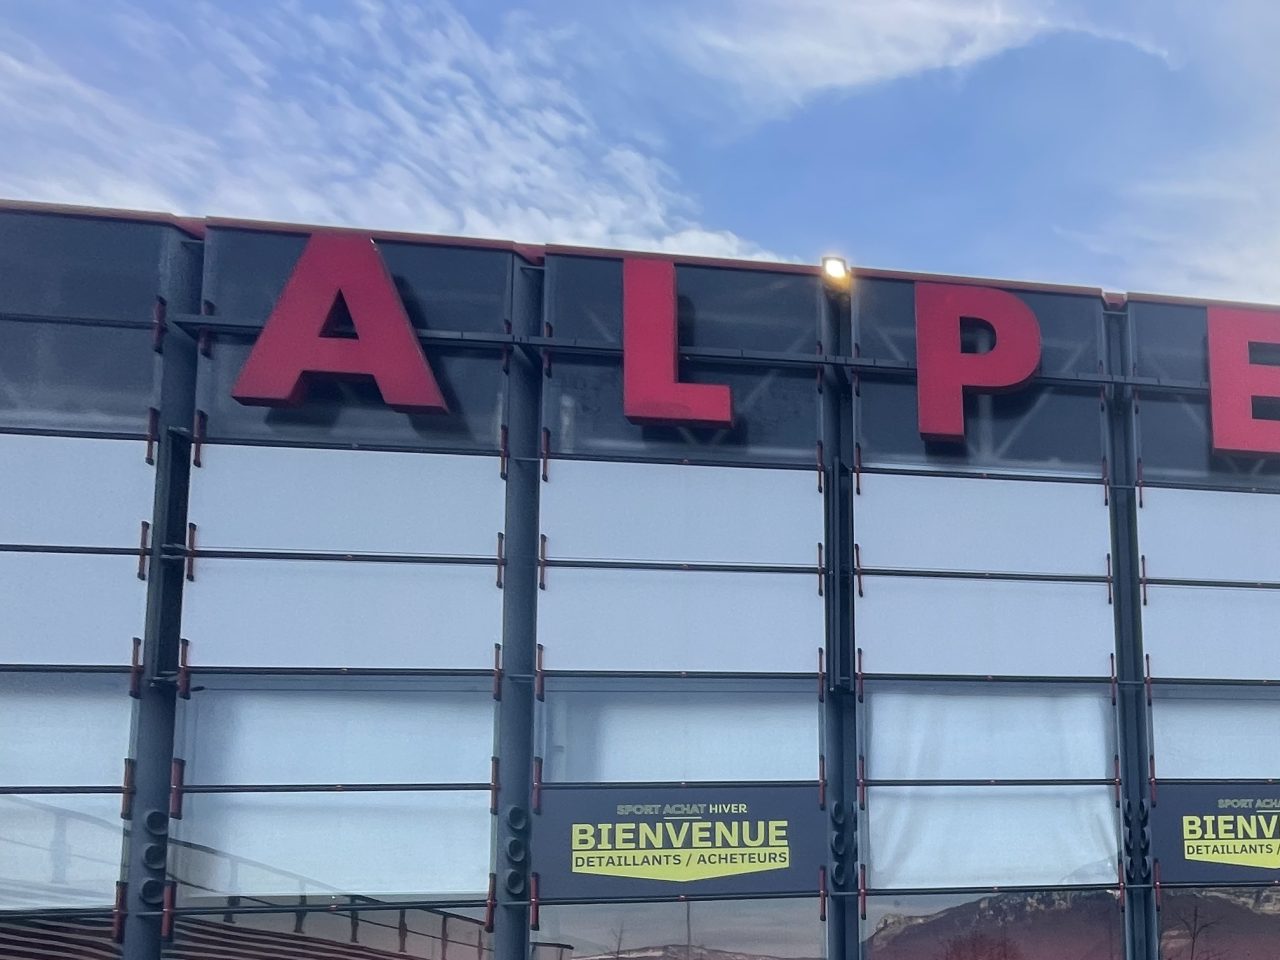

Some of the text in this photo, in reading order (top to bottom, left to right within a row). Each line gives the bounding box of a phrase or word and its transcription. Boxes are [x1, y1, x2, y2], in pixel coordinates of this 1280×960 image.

[617, 803, 747, 815] SPORT ACHAT HIVER
[1218, 799, 1253, 809] SPORT
[572, 820, 788, 850] BIENVENUE
[1186, 843, 1273, 855] DETAILLANTS
[575, 854, 682, 868] DETAILLANTS
[697, 852, 788, 866] ACHETEURS
